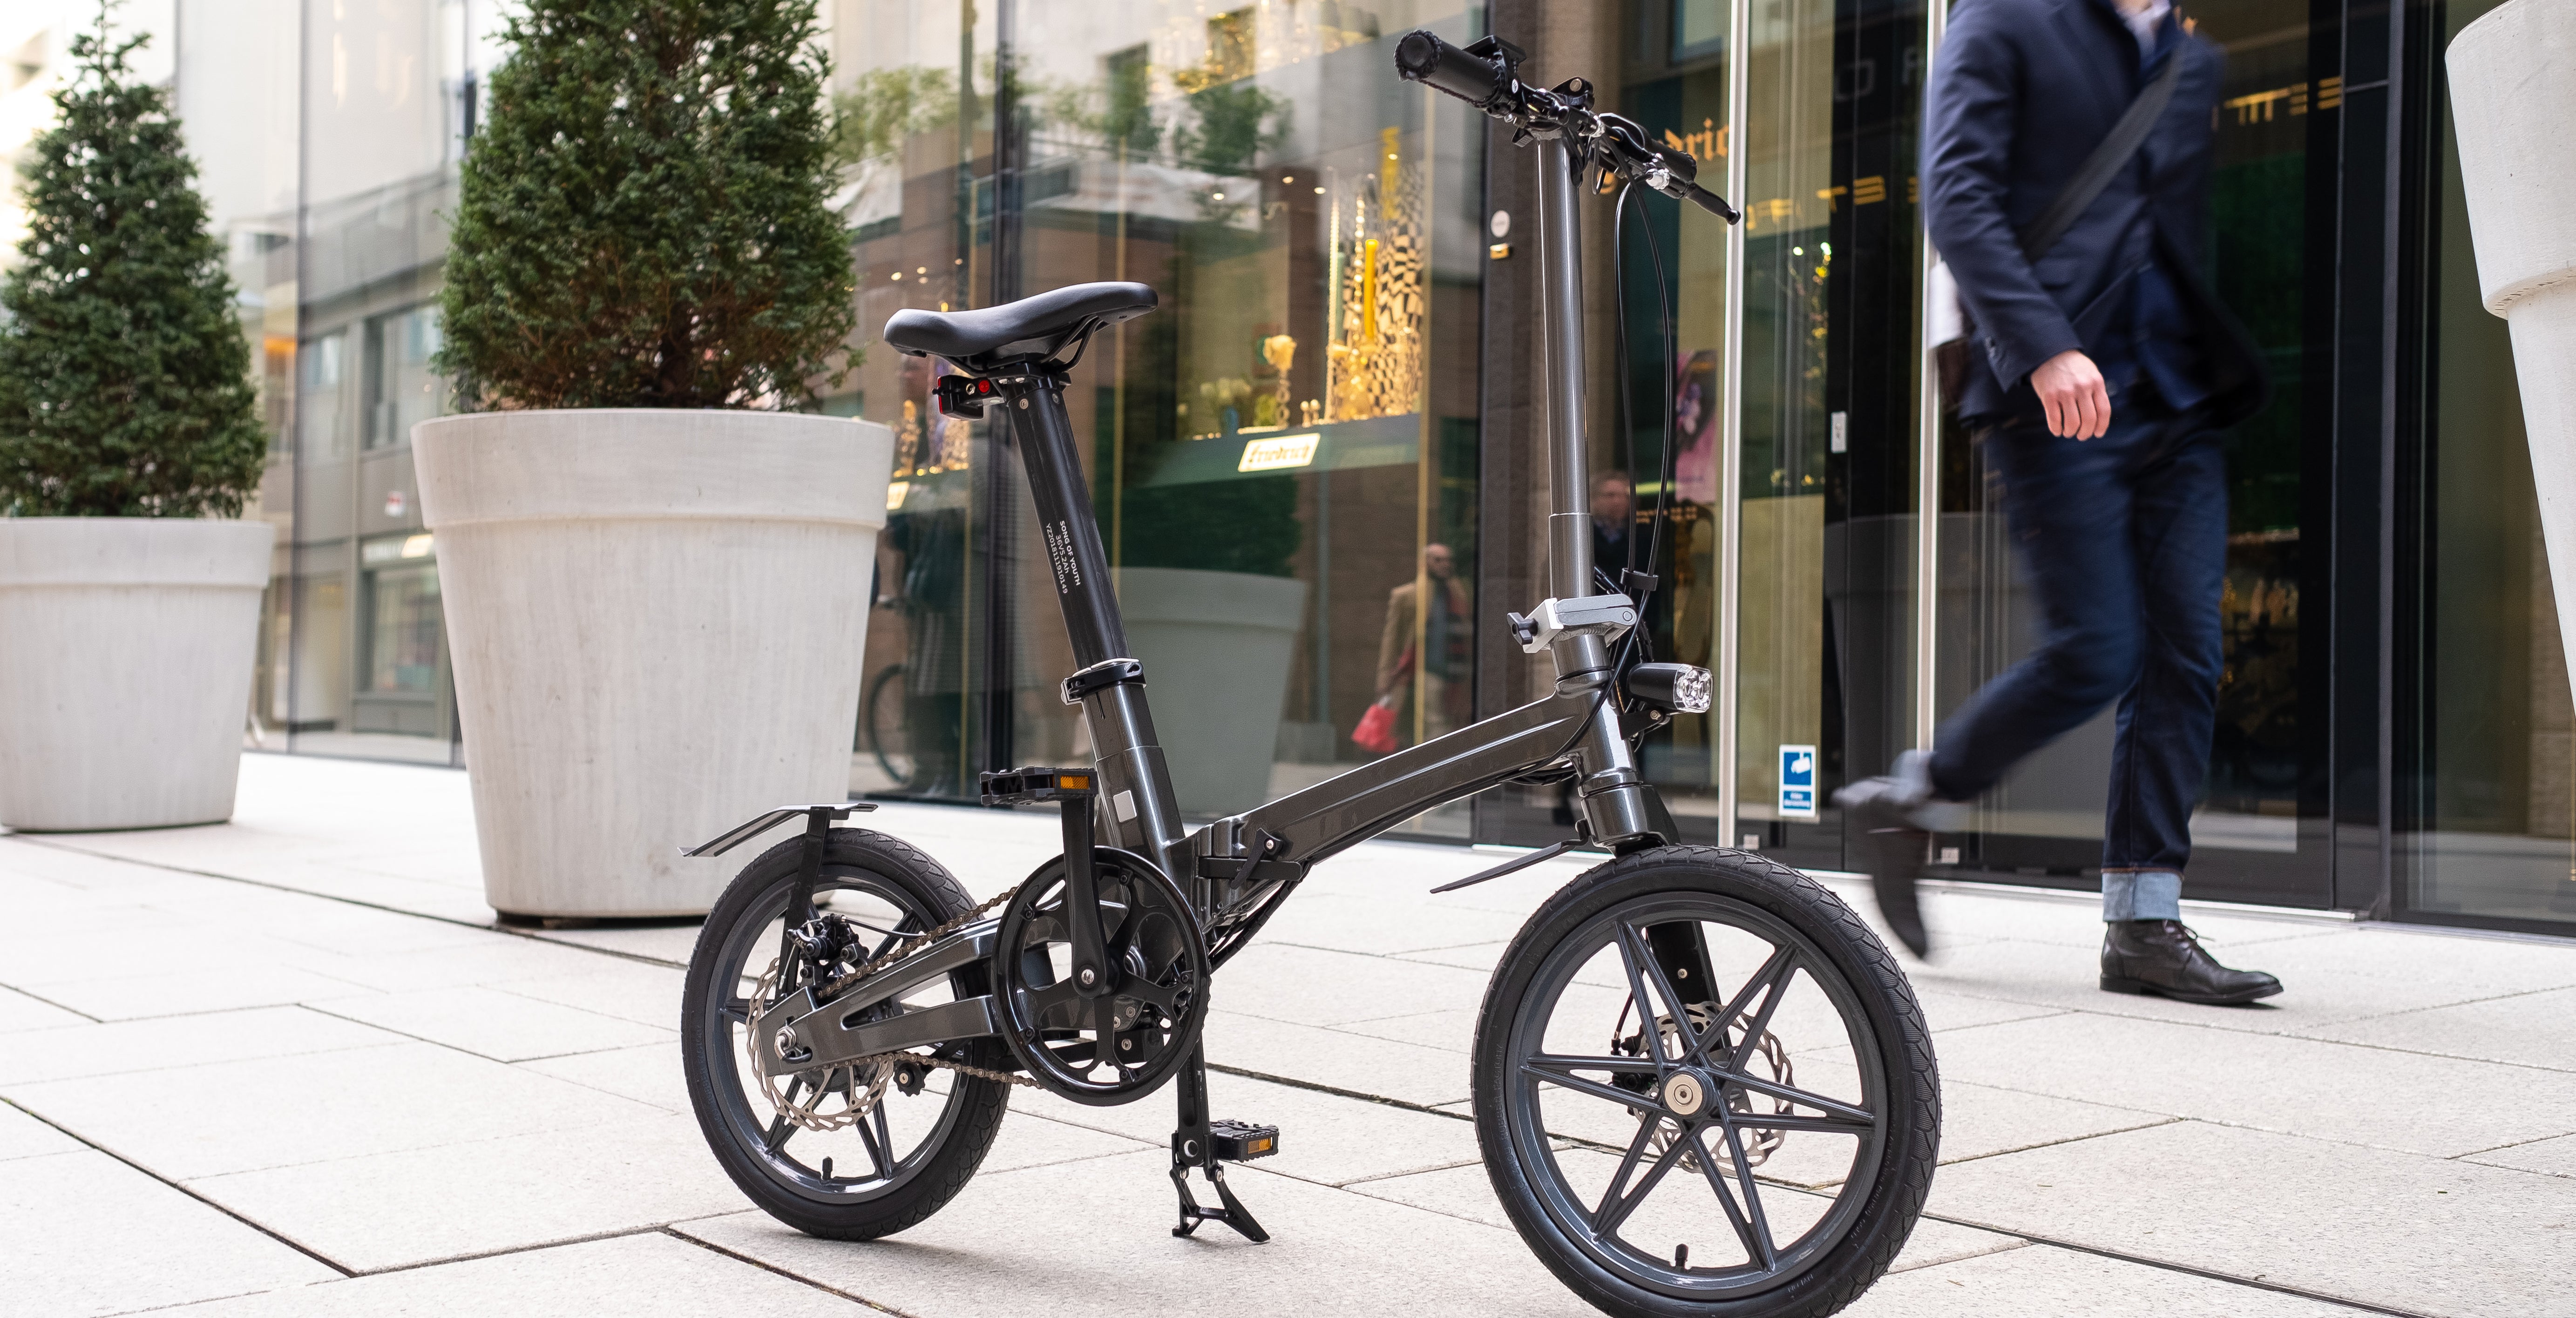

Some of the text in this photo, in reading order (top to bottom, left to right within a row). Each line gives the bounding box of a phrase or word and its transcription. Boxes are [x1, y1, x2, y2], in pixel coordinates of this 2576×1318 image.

[1046, 522, 1068, 594] YZ2018111910149
[1056, 534, 1070, 574] 36V5.2Ah
[1060, 520, 1081, 586] SONG OF YOUTH
[1492, 1044, 1503, 1091] FACTORY
[1495, 1095, 1508, 1141] RUBBER
